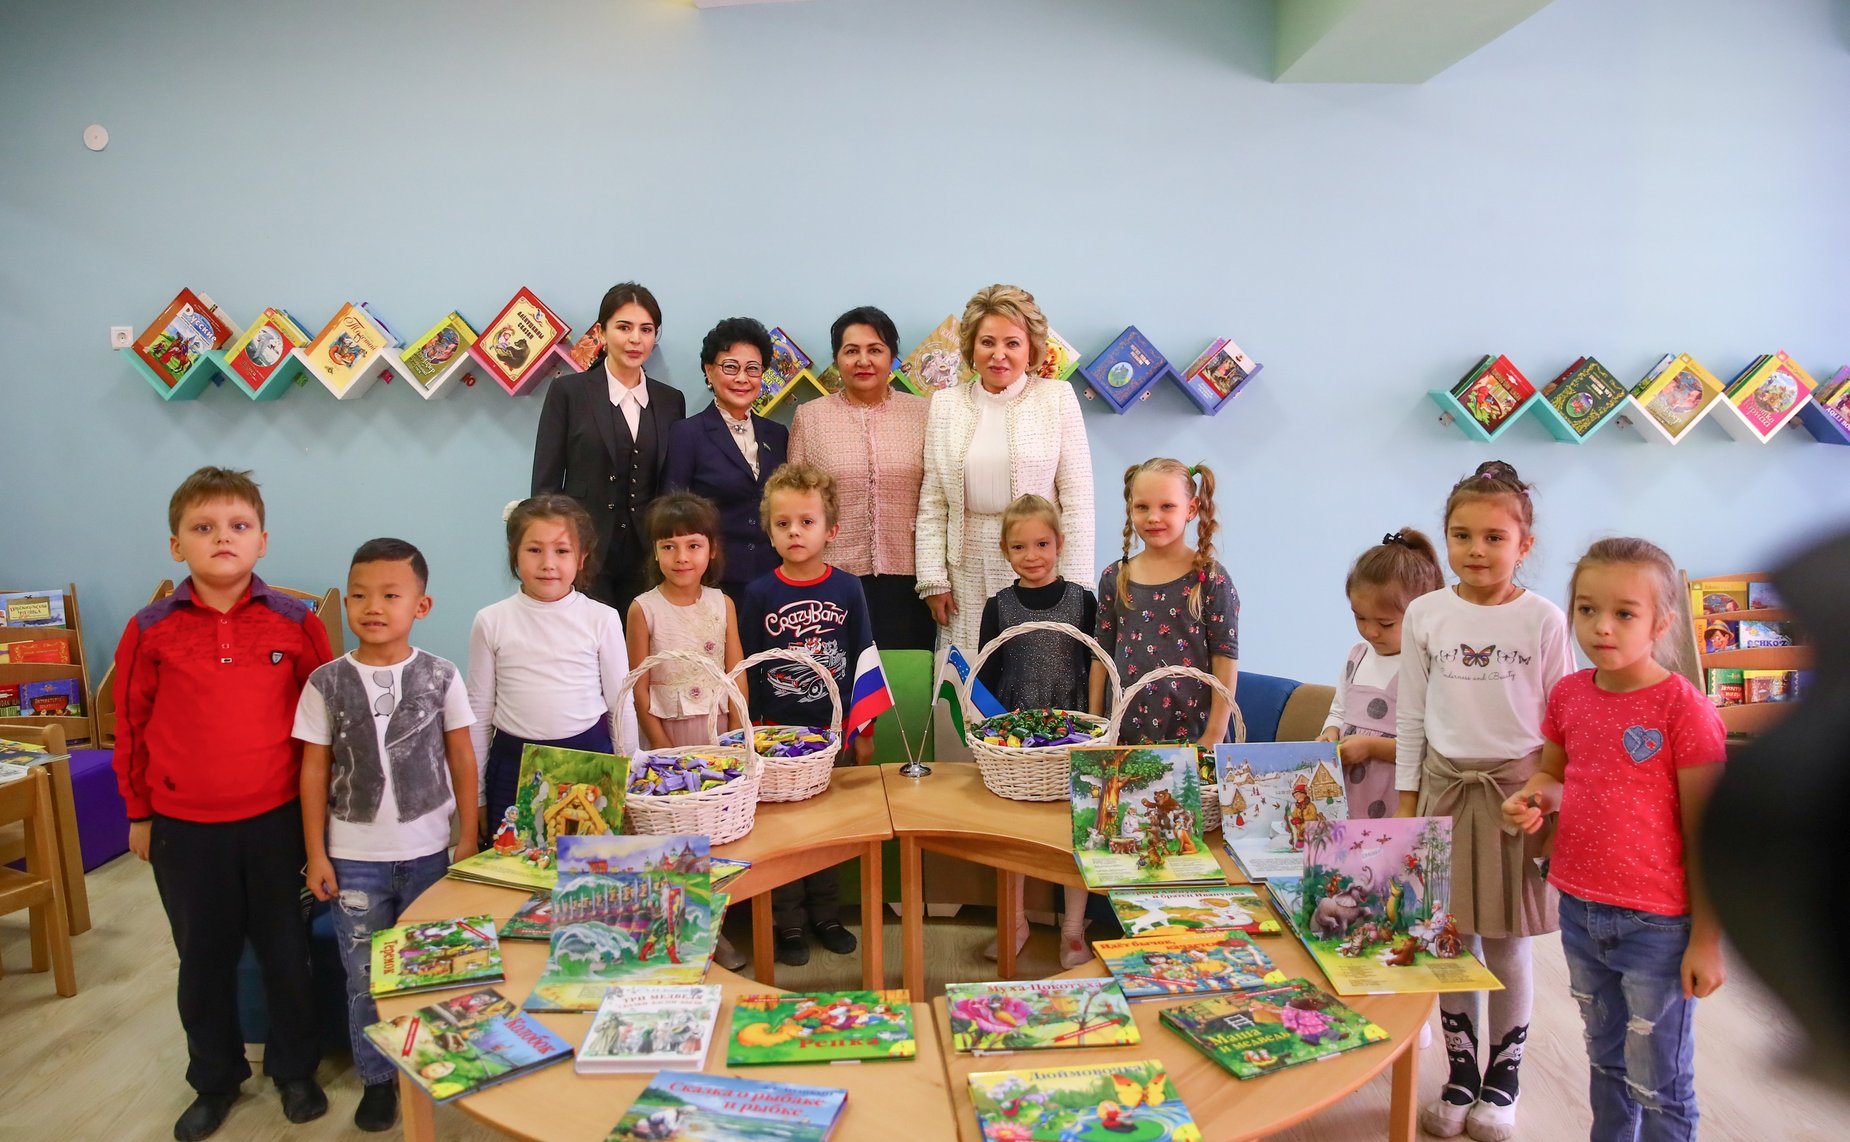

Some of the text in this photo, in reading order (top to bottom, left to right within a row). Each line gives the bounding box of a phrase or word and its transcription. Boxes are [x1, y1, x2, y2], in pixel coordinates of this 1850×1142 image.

[177, 303, 217, 341] Русские
[518, 322, 535, 340] СКАЗКИ
[766, 368, 786, 386] KLAR
[380, 939, 398, 975] Теремок
[504, 1018, 556, 1055] Колобок
[799, 1037, 879, 1049] Репка
[1208, 1029, 1262, 1046] Маша
[1219, 1032, 1291, 1053] и медведь
[1028, 1064, 1145, 1082] Дюймовочка
[669, 1080, 734, 1098] Сказка
[750, 1089, 826, 1107] рыбаке
[723, 1101, 804, 1117] и рыбке
